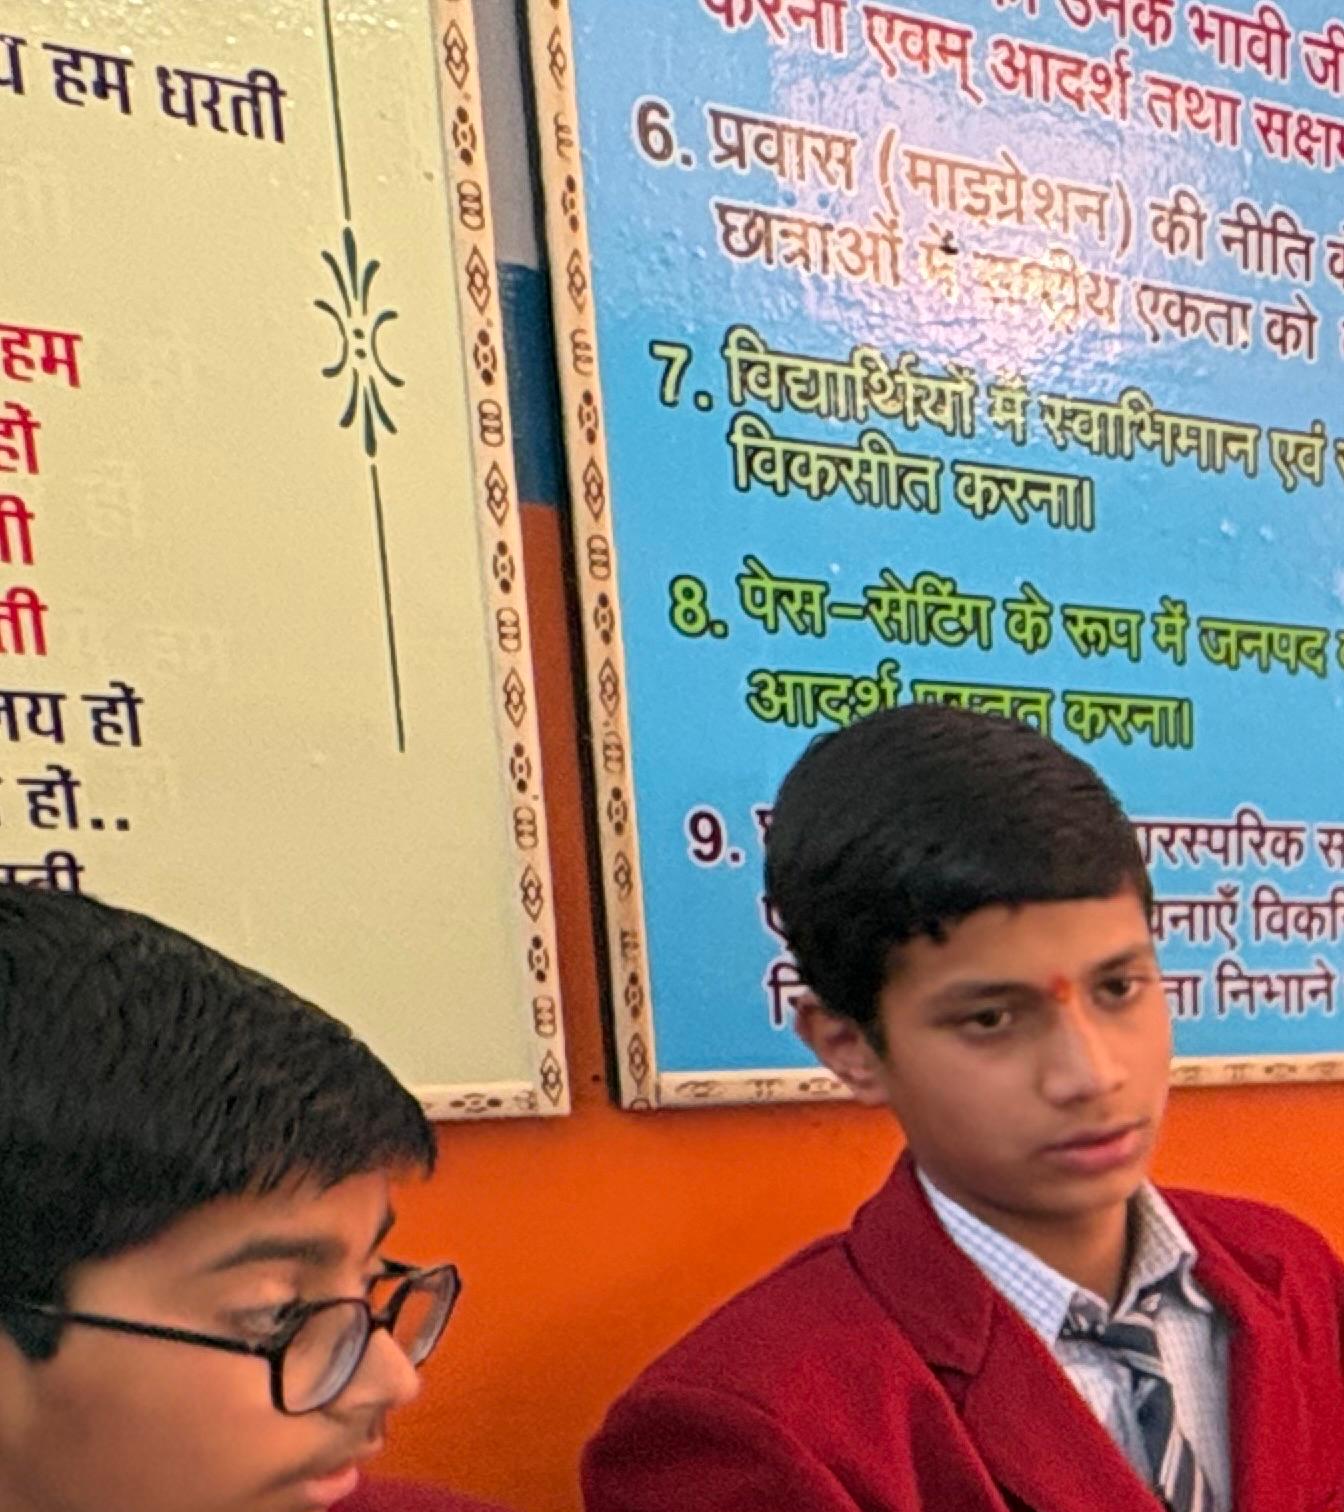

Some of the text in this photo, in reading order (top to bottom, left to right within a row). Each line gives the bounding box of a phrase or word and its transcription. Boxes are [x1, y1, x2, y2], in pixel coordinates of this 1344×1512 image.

[863, 5, 983, 103] एवम्
[992, 49, 1133, 119] आदर्श
[1145, 76, 1240, 145] तथा
[1058, 0, 1174, 46] उनक
[1189, 4, 1290, 79] भावी
[41, 42, 134, 115] हम
[156, 65, 286, 144] धरती
[637, 101, 692, 166] 6.
[709, 109, 857, 189] प्रवास
[1150, 190, 1207, 260] की
[1221, 203, 1314, 282] नीति
[715, 203, 903, 286] छात्राओं
[1138, 285, 1251, 347] एकता
[1265, 293, 1317, 359] को
[0, 323, 82, 388] हम
[651, 342, 712, 410] 7.
[722, 325, 978, 438] विद्यार्थियों
[1039, 387, 1261, 478] स्वाभिमान
[1269, 419, 1326, 492] एवं
[669, 575, 728, 639] 8.
[1003, 581, 1052, 653] के
[1062, 604, 1144, 662] रूप
[1151, 595, 1187, 665] में
[1198, 617, 1328, 678] जनपद
[689, 811, 741, 862] 9.
[1216, 959, 1335, 1014] निभाने
